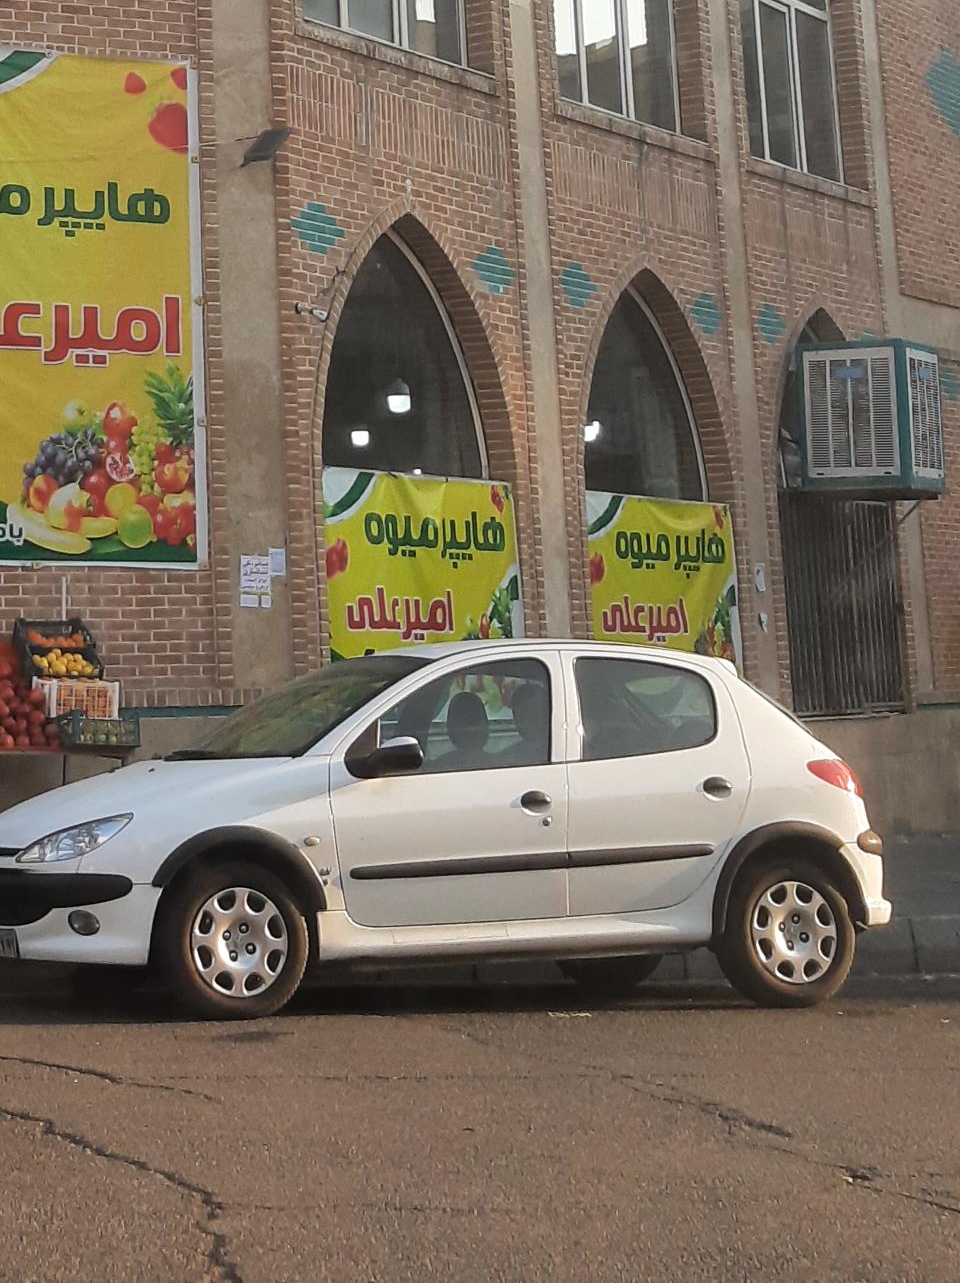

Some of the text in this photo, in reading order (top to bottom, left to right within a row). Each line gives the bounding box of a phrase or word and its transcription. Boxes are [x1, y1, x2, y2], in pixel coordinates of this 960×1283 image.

[37, 182, 171, 237] هایپر
[9, 522, 24, 546] با
[365, 511, 506, 569] هایپر میوه
[615, 528, 726, 579] هایپر میوه
